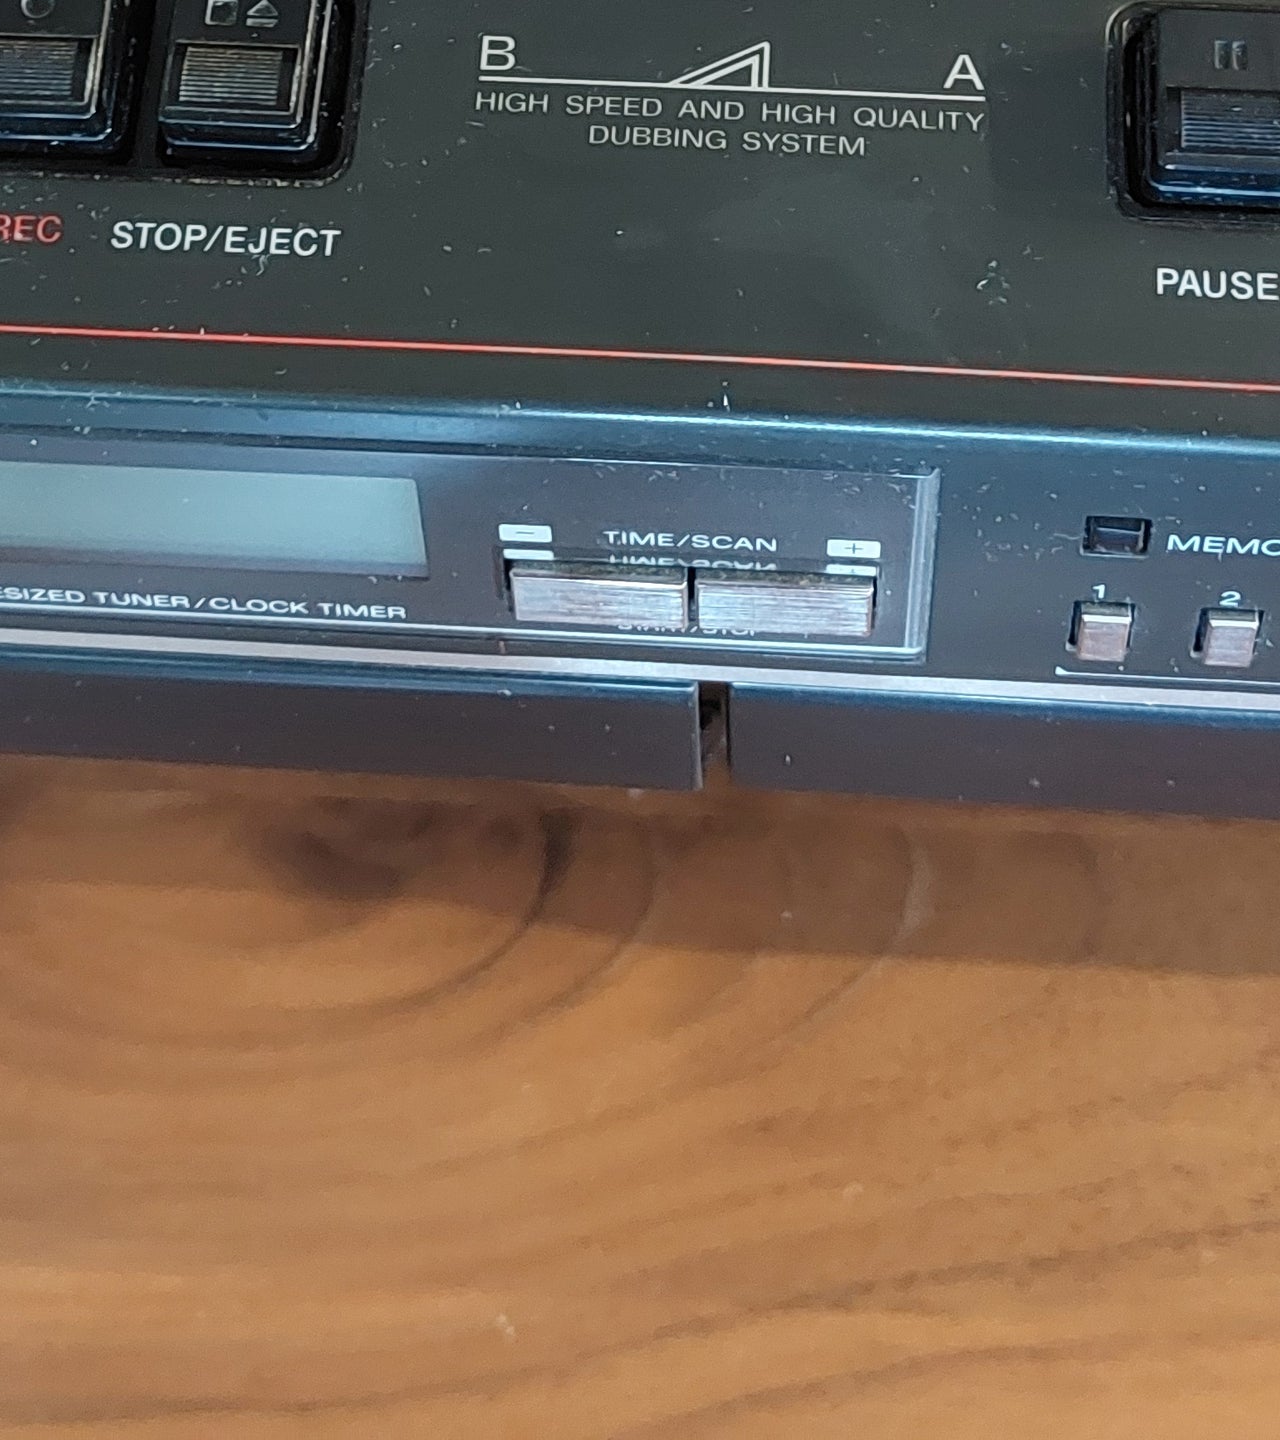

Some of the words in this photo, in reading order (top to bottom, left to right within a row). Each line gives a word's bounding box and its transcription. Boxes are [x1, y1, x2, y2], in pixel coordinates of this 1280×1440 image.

[478, 35, 516, 71] B
[943, 54, 986, 91] A
[475, 91, 549, 112] HIGH
[565, 96, 663, 117] SPEED
[677, 100, 745, 120] AND
[761, 104, 836, 125] HIGH
[853, 108, 985, 132] QUALITY
[588, 124, 727, 150] DUBBING
[742, 132, 866, 156] SYSTEM
[110, 221, 341, 257] STOP/EJECT
[1156, 267, 1280, 301] PAUSE
[605, 530, 777, 553] TIME/SCAN
[94, 591, 308, 615] TUNER/CLOCK
[317, 602, 406, 620] TIMER
[1092, 584, 1107, 599] 1
[1219, 590, 1243, 606] 2
